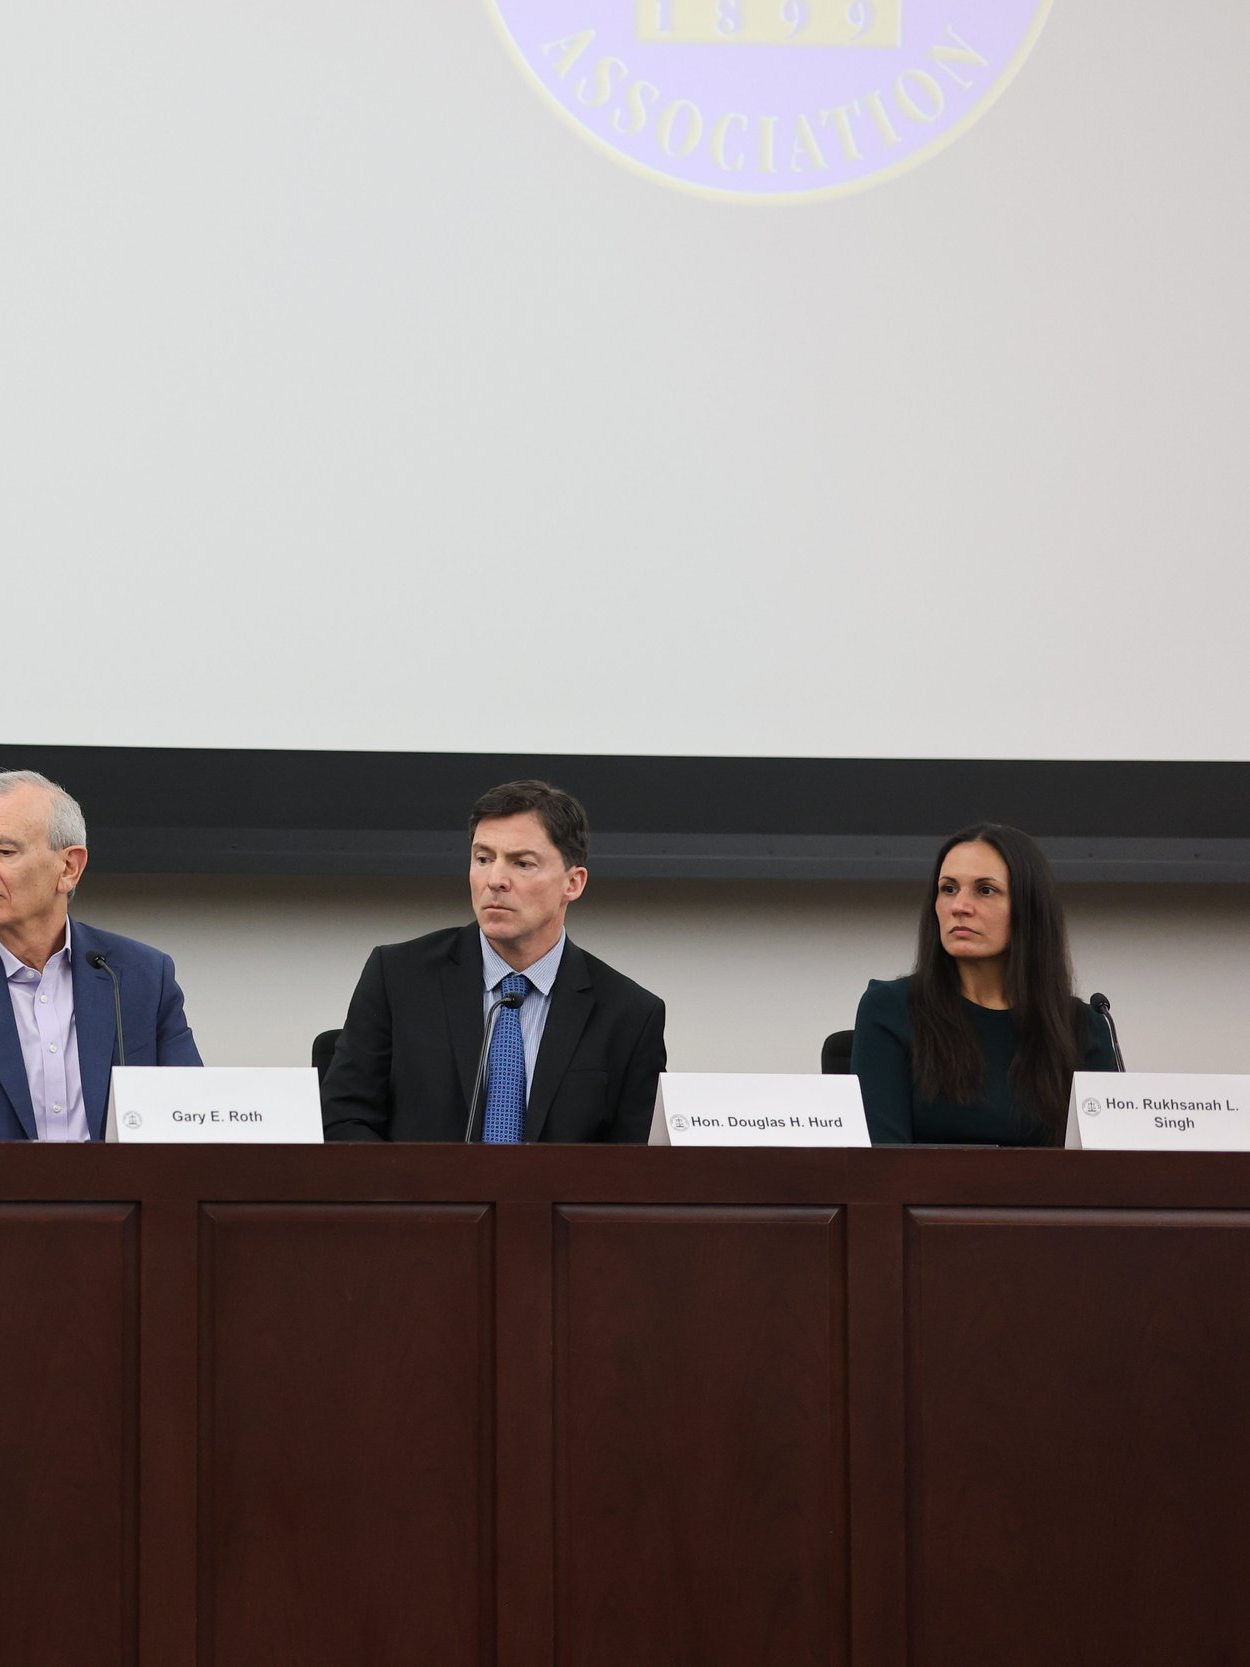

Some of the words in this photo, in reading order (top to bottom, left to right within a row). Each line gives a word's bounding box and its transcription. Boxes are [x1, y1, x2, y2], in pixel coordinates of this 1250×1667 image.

[654, 0, 875, 41] 1899
[540, 22, 989, 175] ASSOCIATION
[1105, 1097, 1139, 1110] Hon.
[1142, 1098, 1222, 1112] Rukhsanah
[1225, 1099, 1239, 1112] L.
[172, 1110, 206, 1125] Gary
[210, 1110, 224, 1122] E.
[228, 1110, 263, 1123] Roth
[690, 1115, 724, 1128] Hon.
[727, 1116, 786, 1131] Douglas
[789, 1116, 805, 1128] H.
[808, 1116, 843, 1128] Hurd
[1154, 1116, 1195, 1132] Singh
